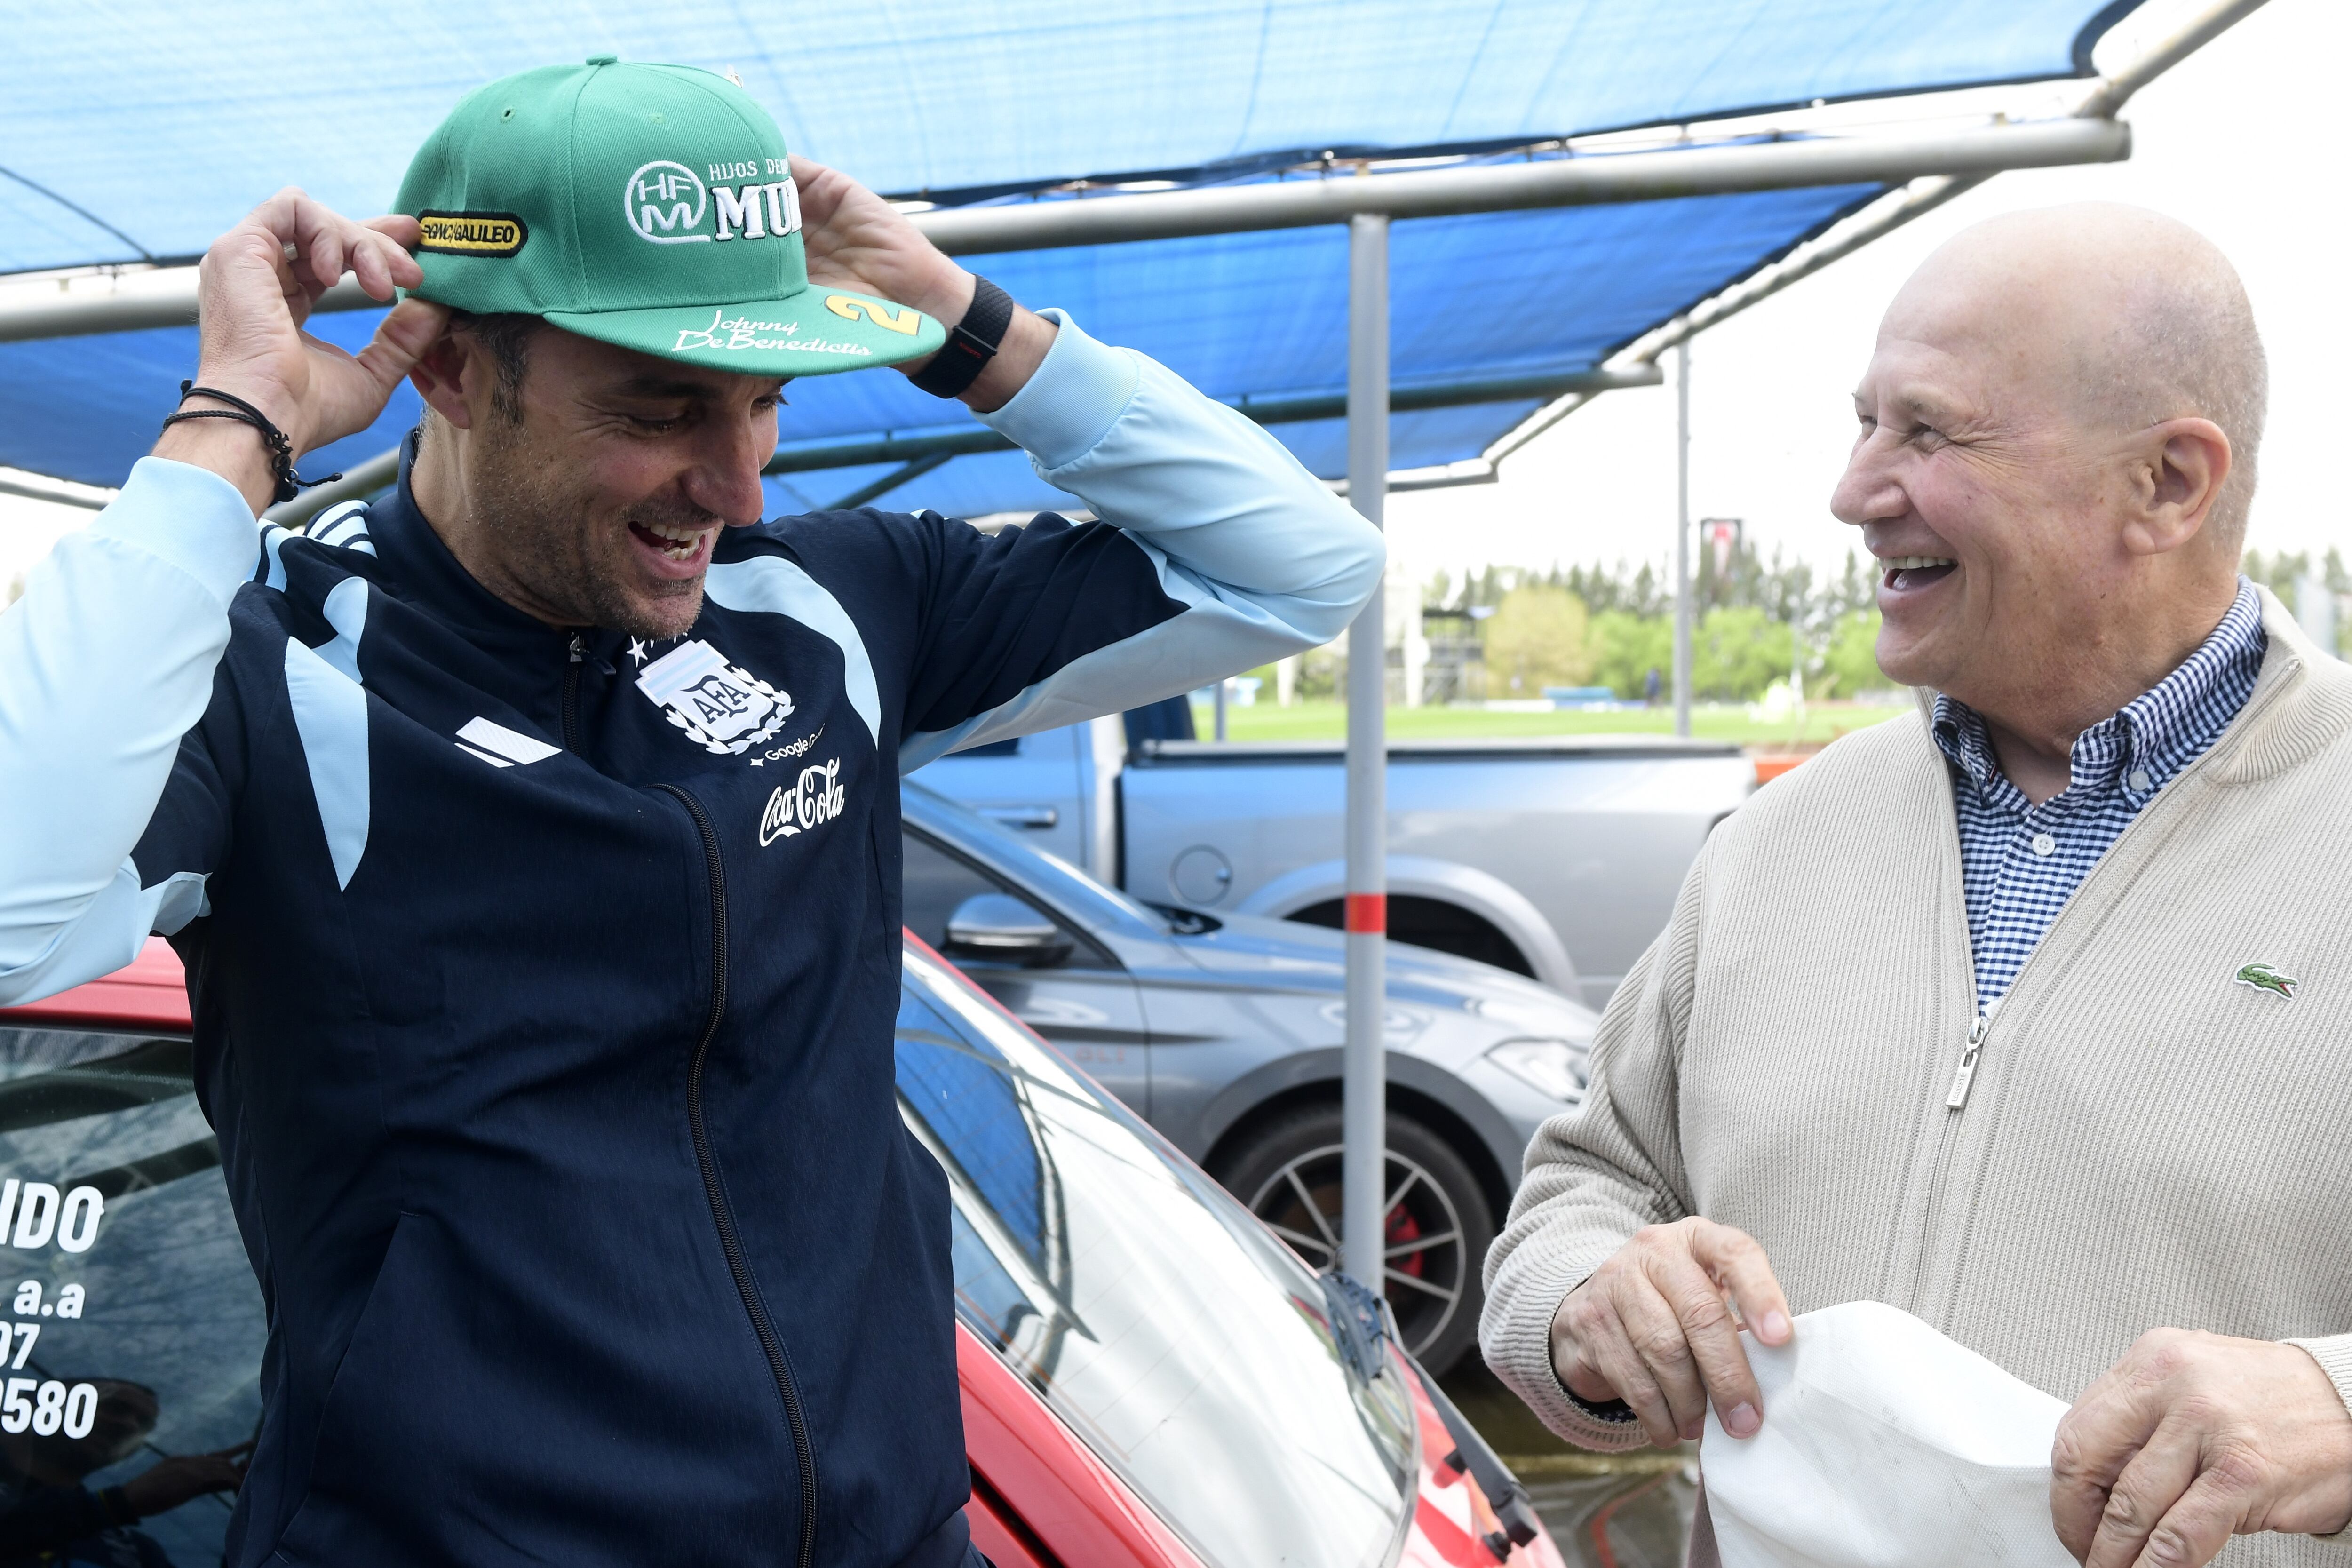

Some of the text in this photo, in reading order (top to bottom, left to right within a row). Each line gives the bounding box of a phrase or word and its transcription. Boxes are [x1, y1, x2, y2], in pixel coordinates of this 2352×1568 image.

[708, 161, 759, 181] HIJOS
[695, 310, 799, 337] Johnny
[824, 295, 922, 336] 2
[680, 675, 752, 724] AFA
[765, 738, 808, 761] Google
[759, 756, 845, 847] Coca-Cola
[1952, 1072, 1966, 1102] LACOSTE
[0, 1377, 99, 1440] 580
